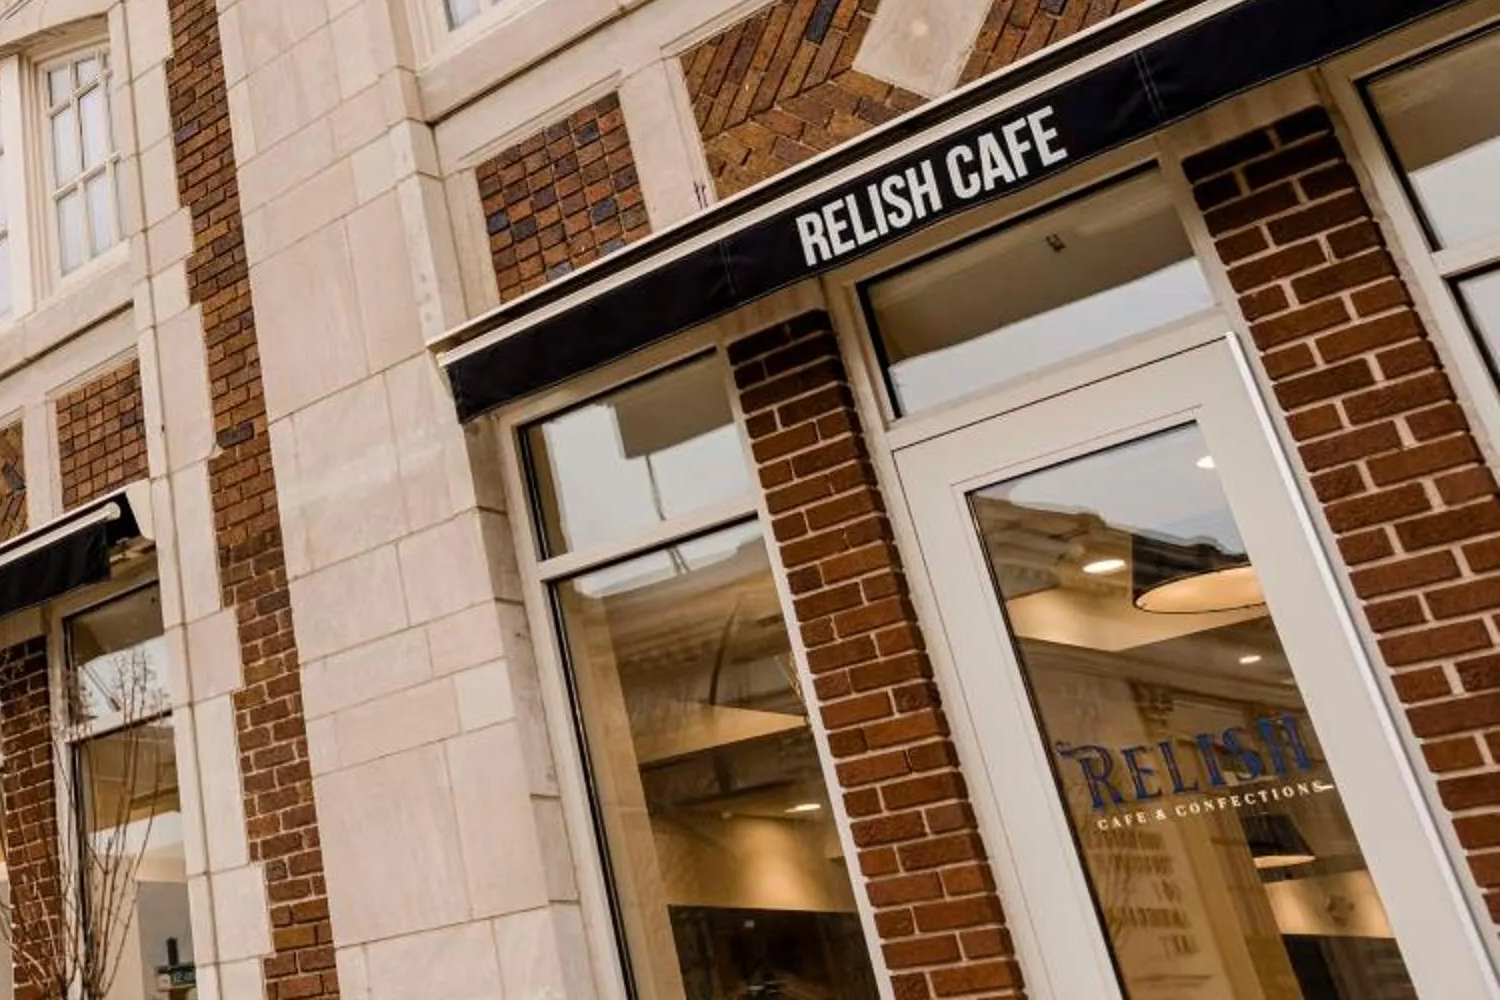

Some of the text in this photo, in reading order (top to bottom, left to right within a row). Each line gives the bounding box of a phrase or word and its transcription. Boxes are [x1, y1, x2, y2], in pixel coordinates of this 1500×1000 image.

[796, 105, 1068, 266] RELISH CAFE
[1055, 712, 1312, 811] RELISH
[1097, 780, 1324, 831] CAFE & CONFECTIONS
